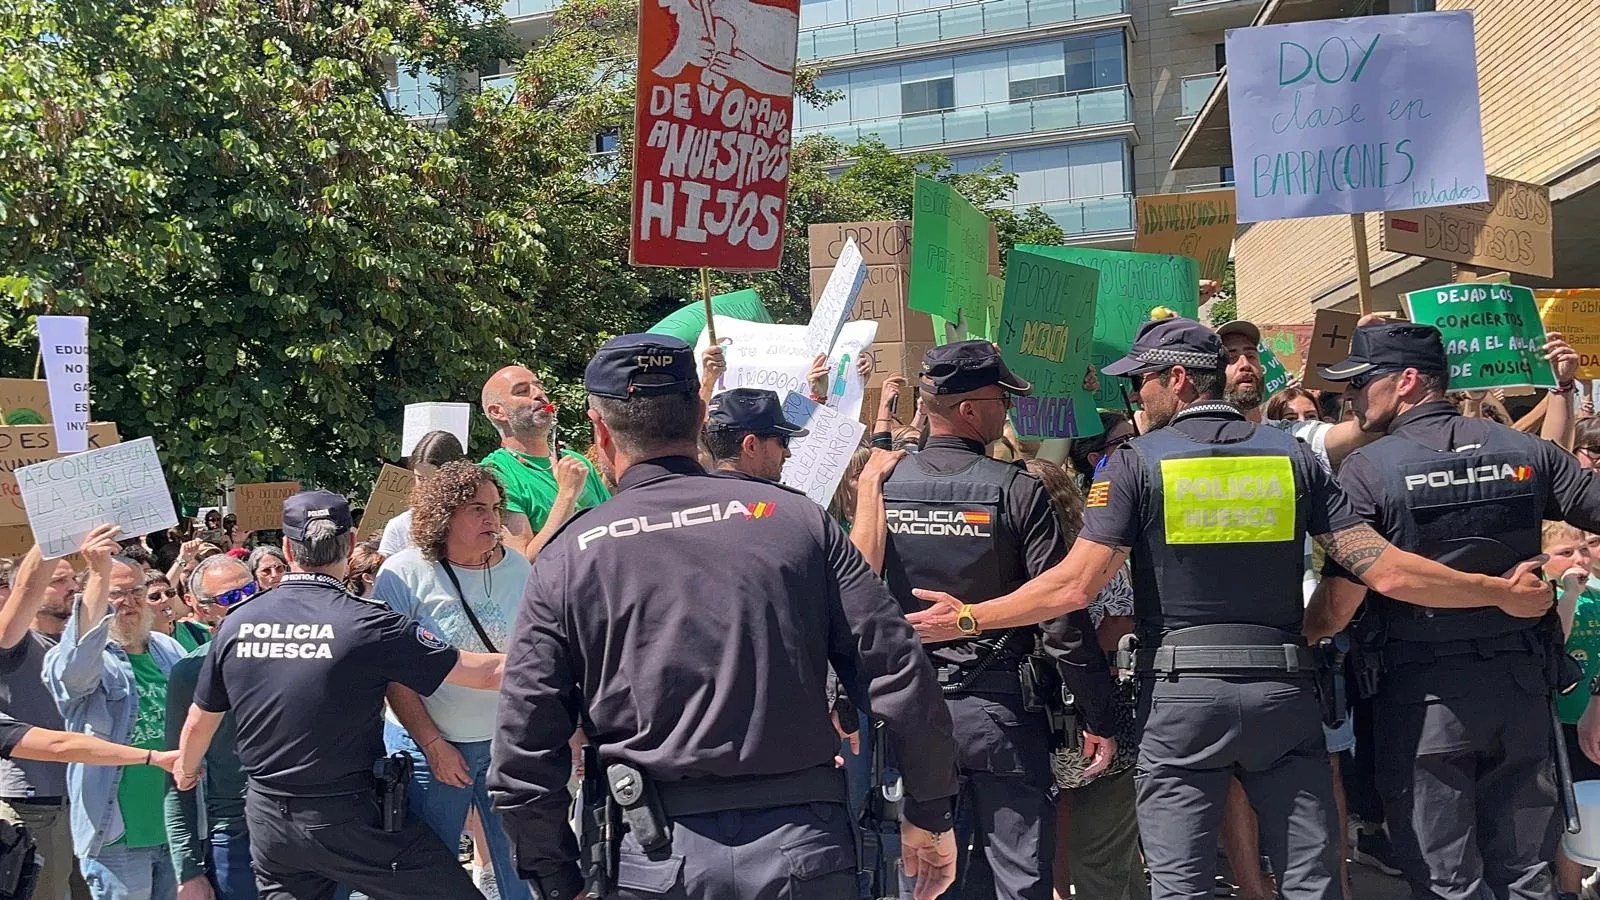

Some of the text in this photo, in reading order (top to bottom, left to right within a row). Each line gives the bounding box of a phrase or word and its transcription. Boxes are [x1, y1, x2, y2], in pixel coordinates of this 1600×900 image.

[1279, 34, 1381, 86] DOY
[650, 83, 791, 144] DEVORANDO
[1272, 90, 1432, 134] clase en
[659, 125, 789, 189] NUESTROS
[1254, 140, 1414, 198] BARRACONES
[1412, 176, 1480, 206] helados
[640, 180, 782, 251] HIJOS
[1436, 288, 1513, 305] DEJAD LOS
[1435, 312, 1524, 329] CONCIERTOS
[1442, 339, 1480, 354] ARA
[1485, 335, 1504, 350] EL
[65, 364, 84, 374] NO
[637, 355, 673, 371] CNP
[1449, 362, 1473, 378] DE
[20, 432, 50, 449] ES
[25, 457, 90, 488] AZCON
[1405, 463, 1518, 491] POLICIA
[1175, 475, 1283, 500] POLICIA
[36, 487, 66, 515] LA
[112, 496, 130, 510] EN
[378, 502, 395, 516] LA
[577, 500, 752, 551] POLICIA
[886, 509, 967, 523] POLICIA
[1184, 508, 1277, 528] HUESCA
[886, 523, 990, 537] NACIONAL
[48, 527, 77, 554] LA
[238, 623, 335, 639] POLICIA
[236, 642, 333, 659] HUESCA
